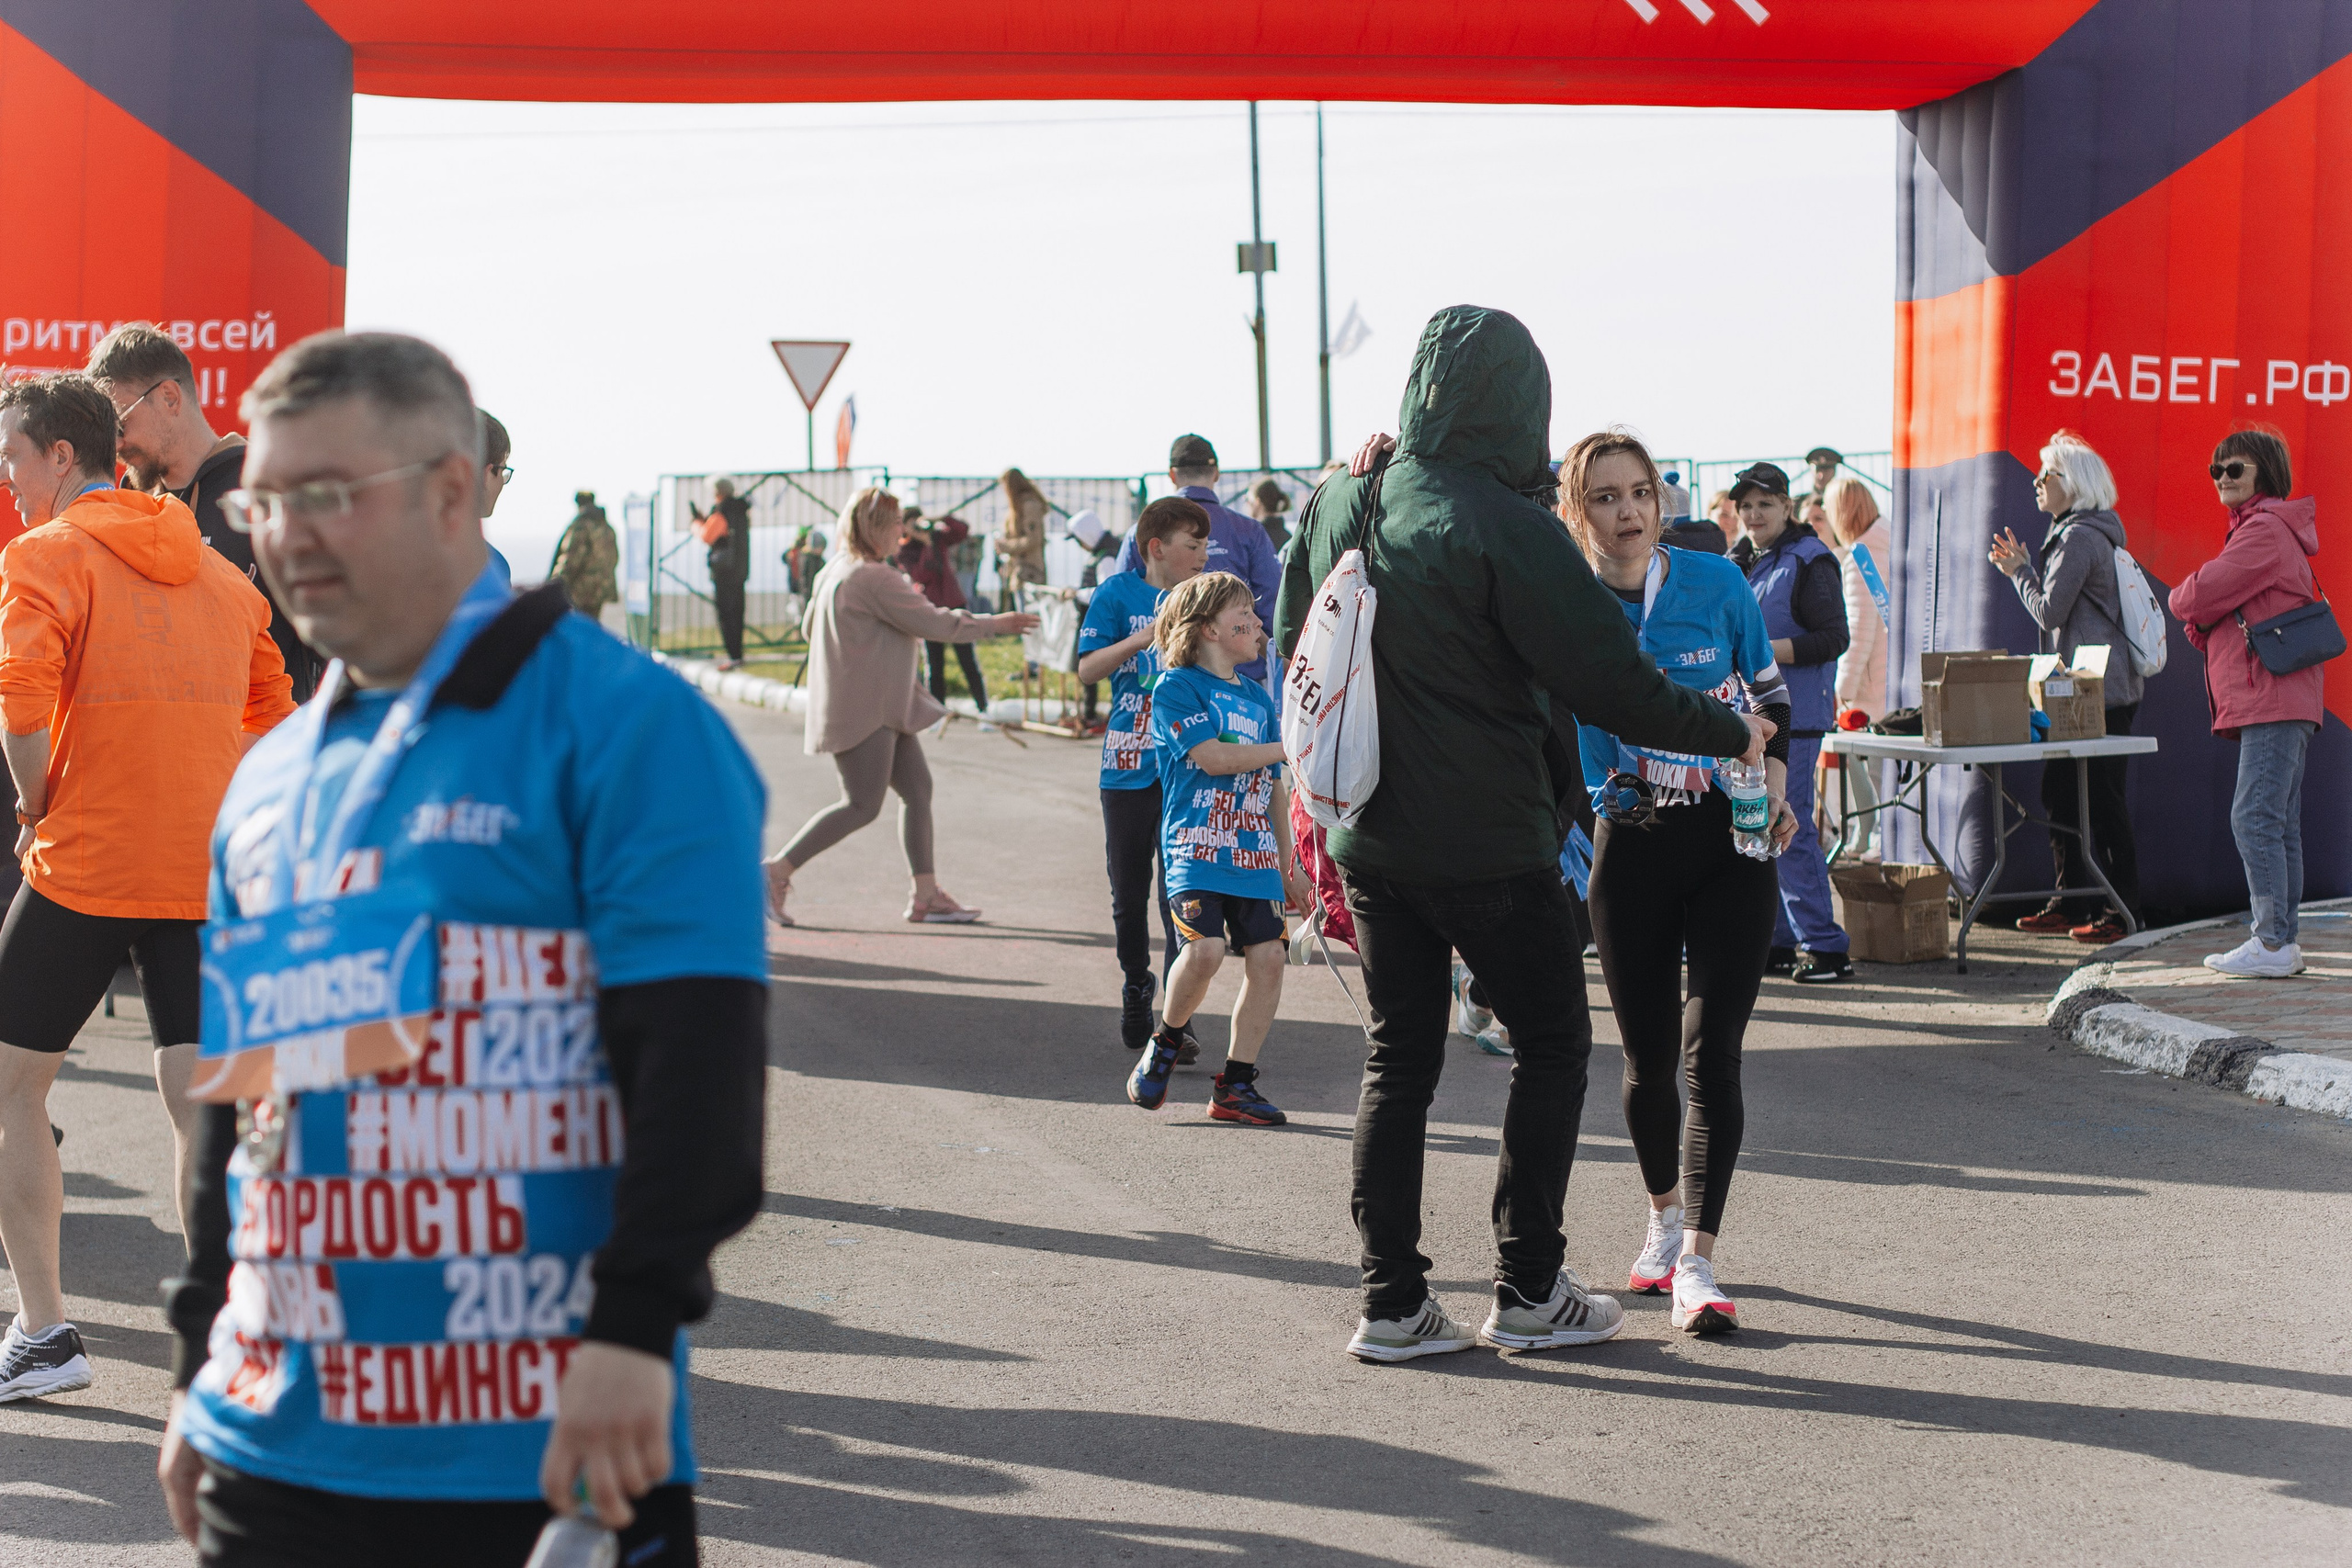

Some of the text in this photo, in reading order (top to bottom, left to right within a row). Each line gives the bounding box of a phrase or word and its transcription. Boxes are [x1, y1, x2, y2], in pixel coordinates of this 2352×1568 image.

[171, 310, 275, 349] всей
[2049, 349, 2351, 407] ЗАБЕГ.РФ
[1735, 802, 1764, 815] АКВА
[243, 947, 390, 1038] 20035
